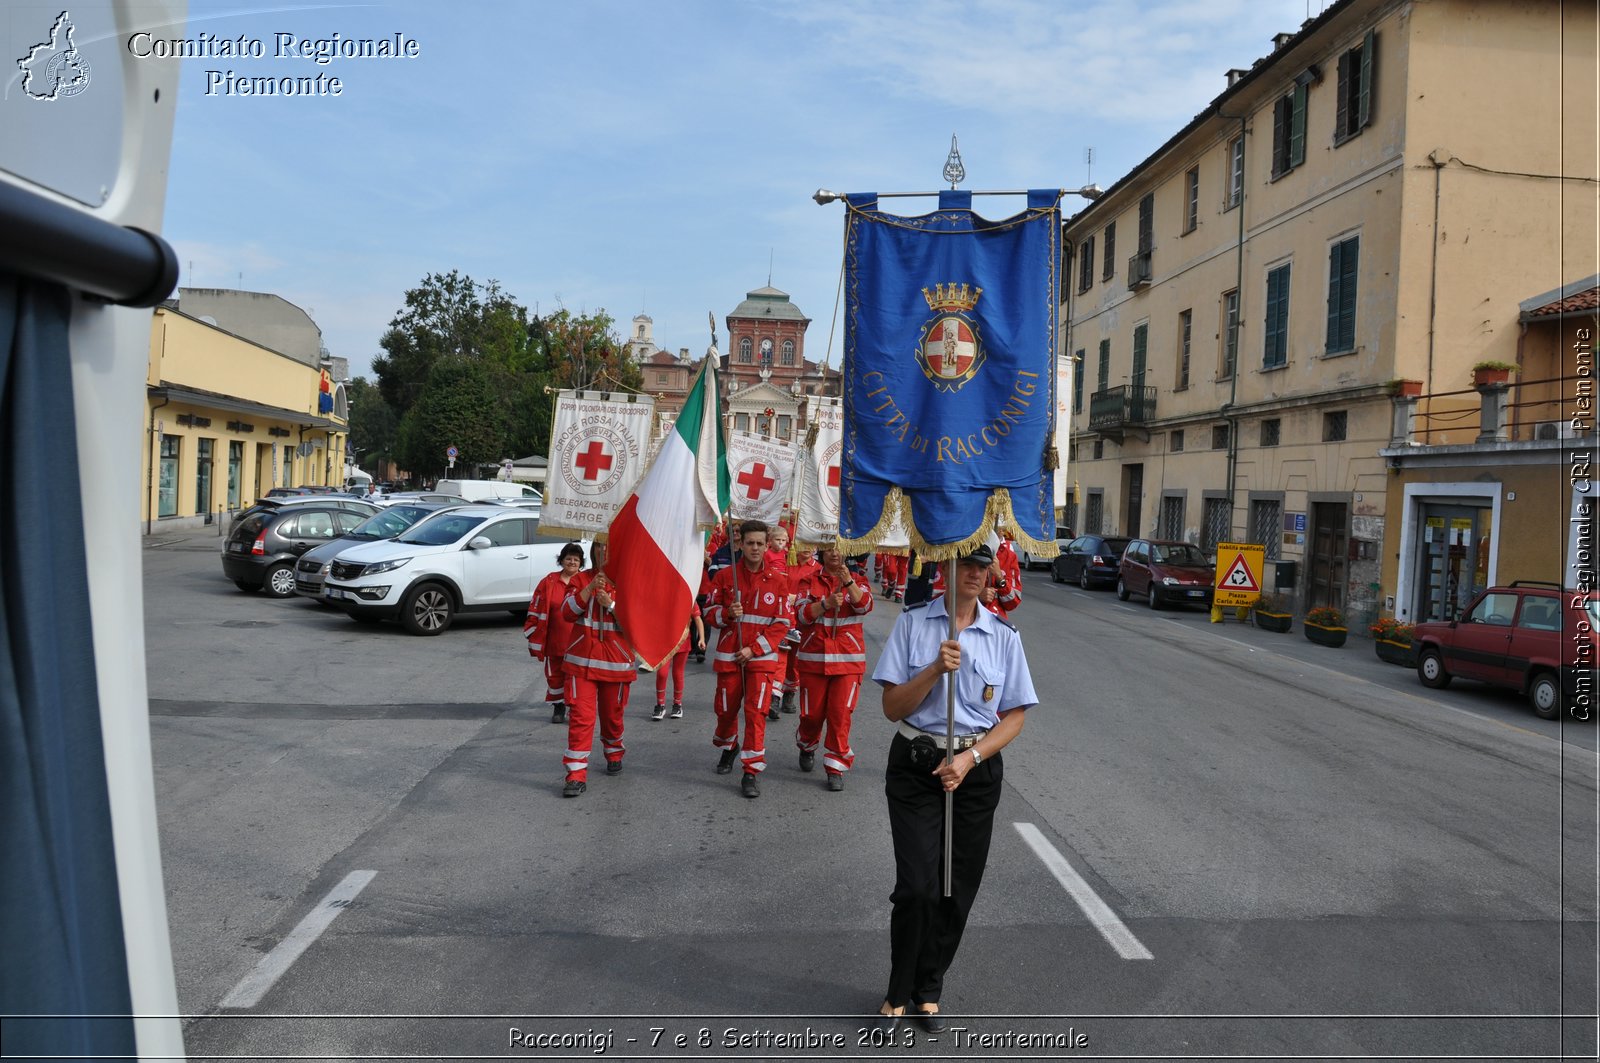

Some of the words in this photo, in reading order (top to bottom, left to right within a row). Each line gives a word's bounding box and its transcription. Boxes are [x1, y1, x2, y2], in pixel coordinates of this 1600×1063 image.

[606, 406, 617, 414] DEL
[909, 434, 929, 454] DI
[936, 369, 1040, 465] RACCONIGI
[555, 422, 579, 453] CROCE
[581, 415, 614, 428] ROSSA
[613, 420, 639, 459] ITALIANA
[574, 436, 583, 444] DI
[583, 427, 613, 440] GINEVRA
[612, 437, 622, 448] 22
[563, 443, 582, 491] CONVENZIONE
[615, 448, 625, 481] AGOSTO
[554, 497, 610, 511] DELEGAZIONE
[565, 510, 604, 523] BARGE
